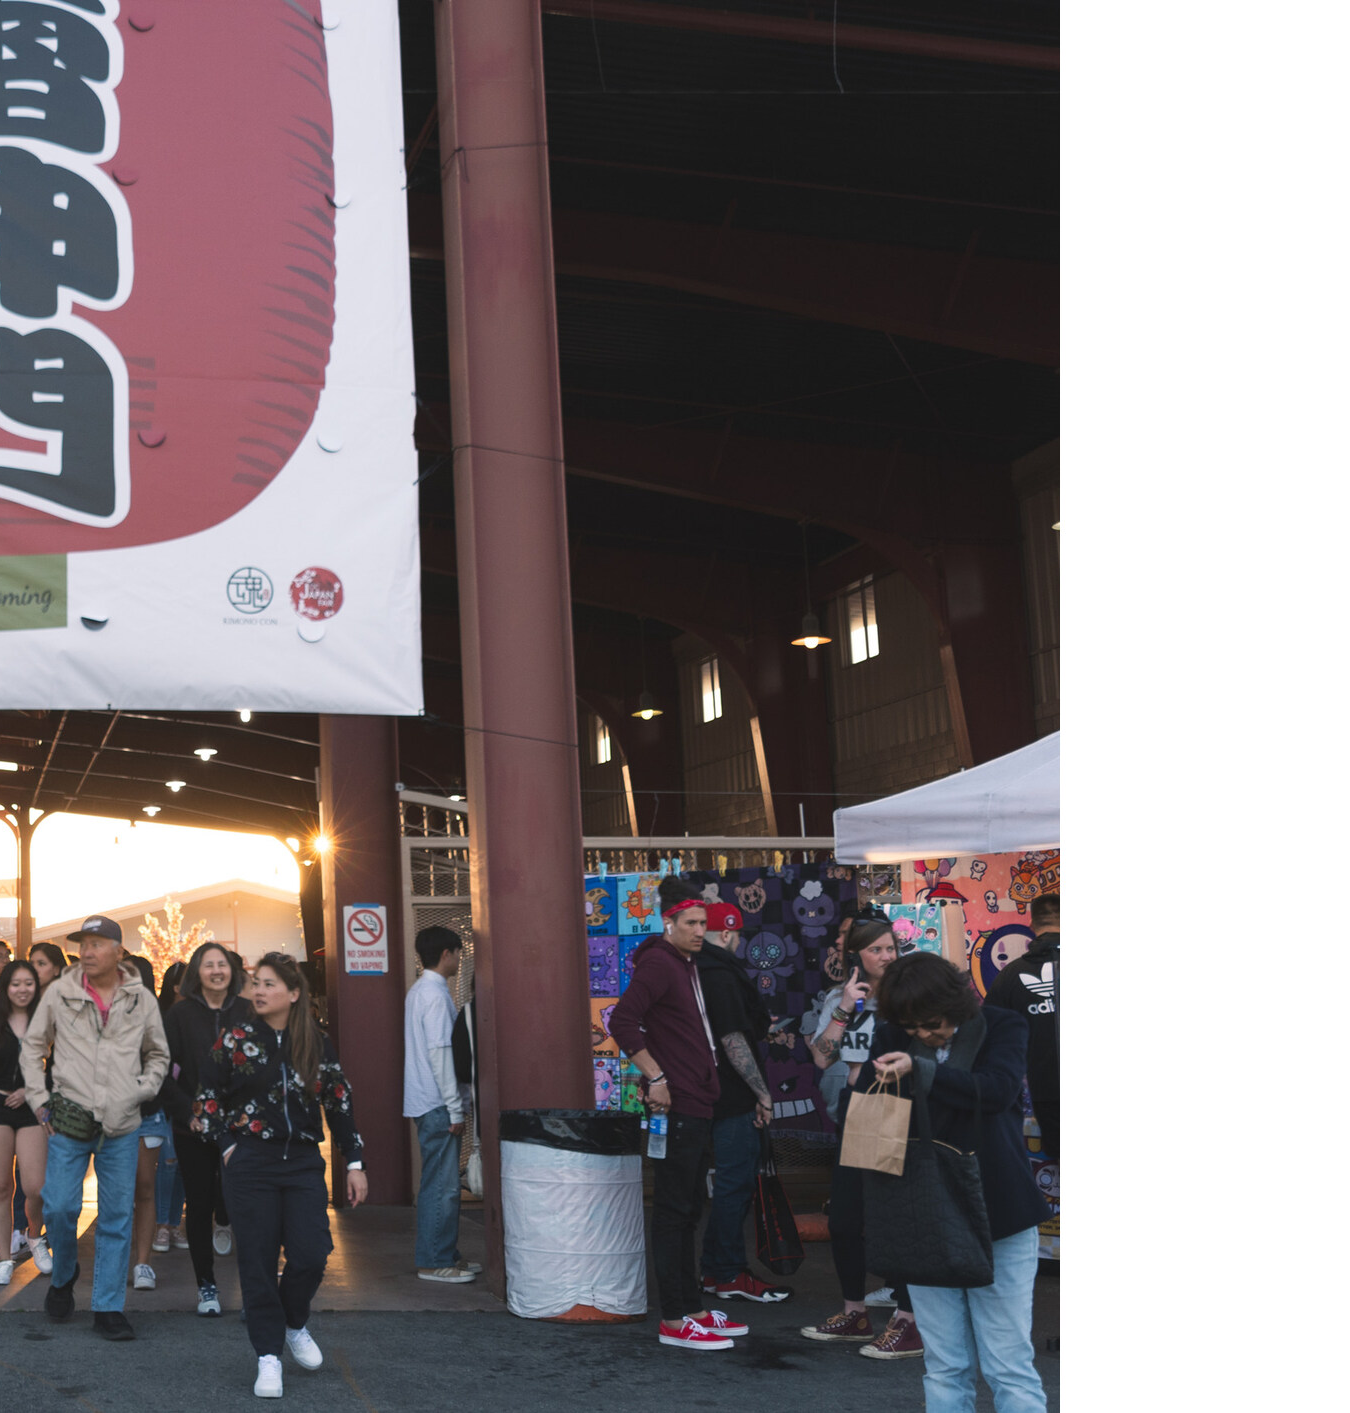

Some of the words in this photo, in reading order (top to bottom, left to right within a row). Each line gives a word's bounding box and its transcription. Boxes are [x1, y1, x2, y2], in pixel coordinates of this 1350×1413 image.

[632, 925, 638, 933] El
[641, 924, 651, 933] Sol
[347, 950, 355, 958] NO
[357, 950, 386, 958] SMOKING
[1028, 999, 1055, 1014] adi
